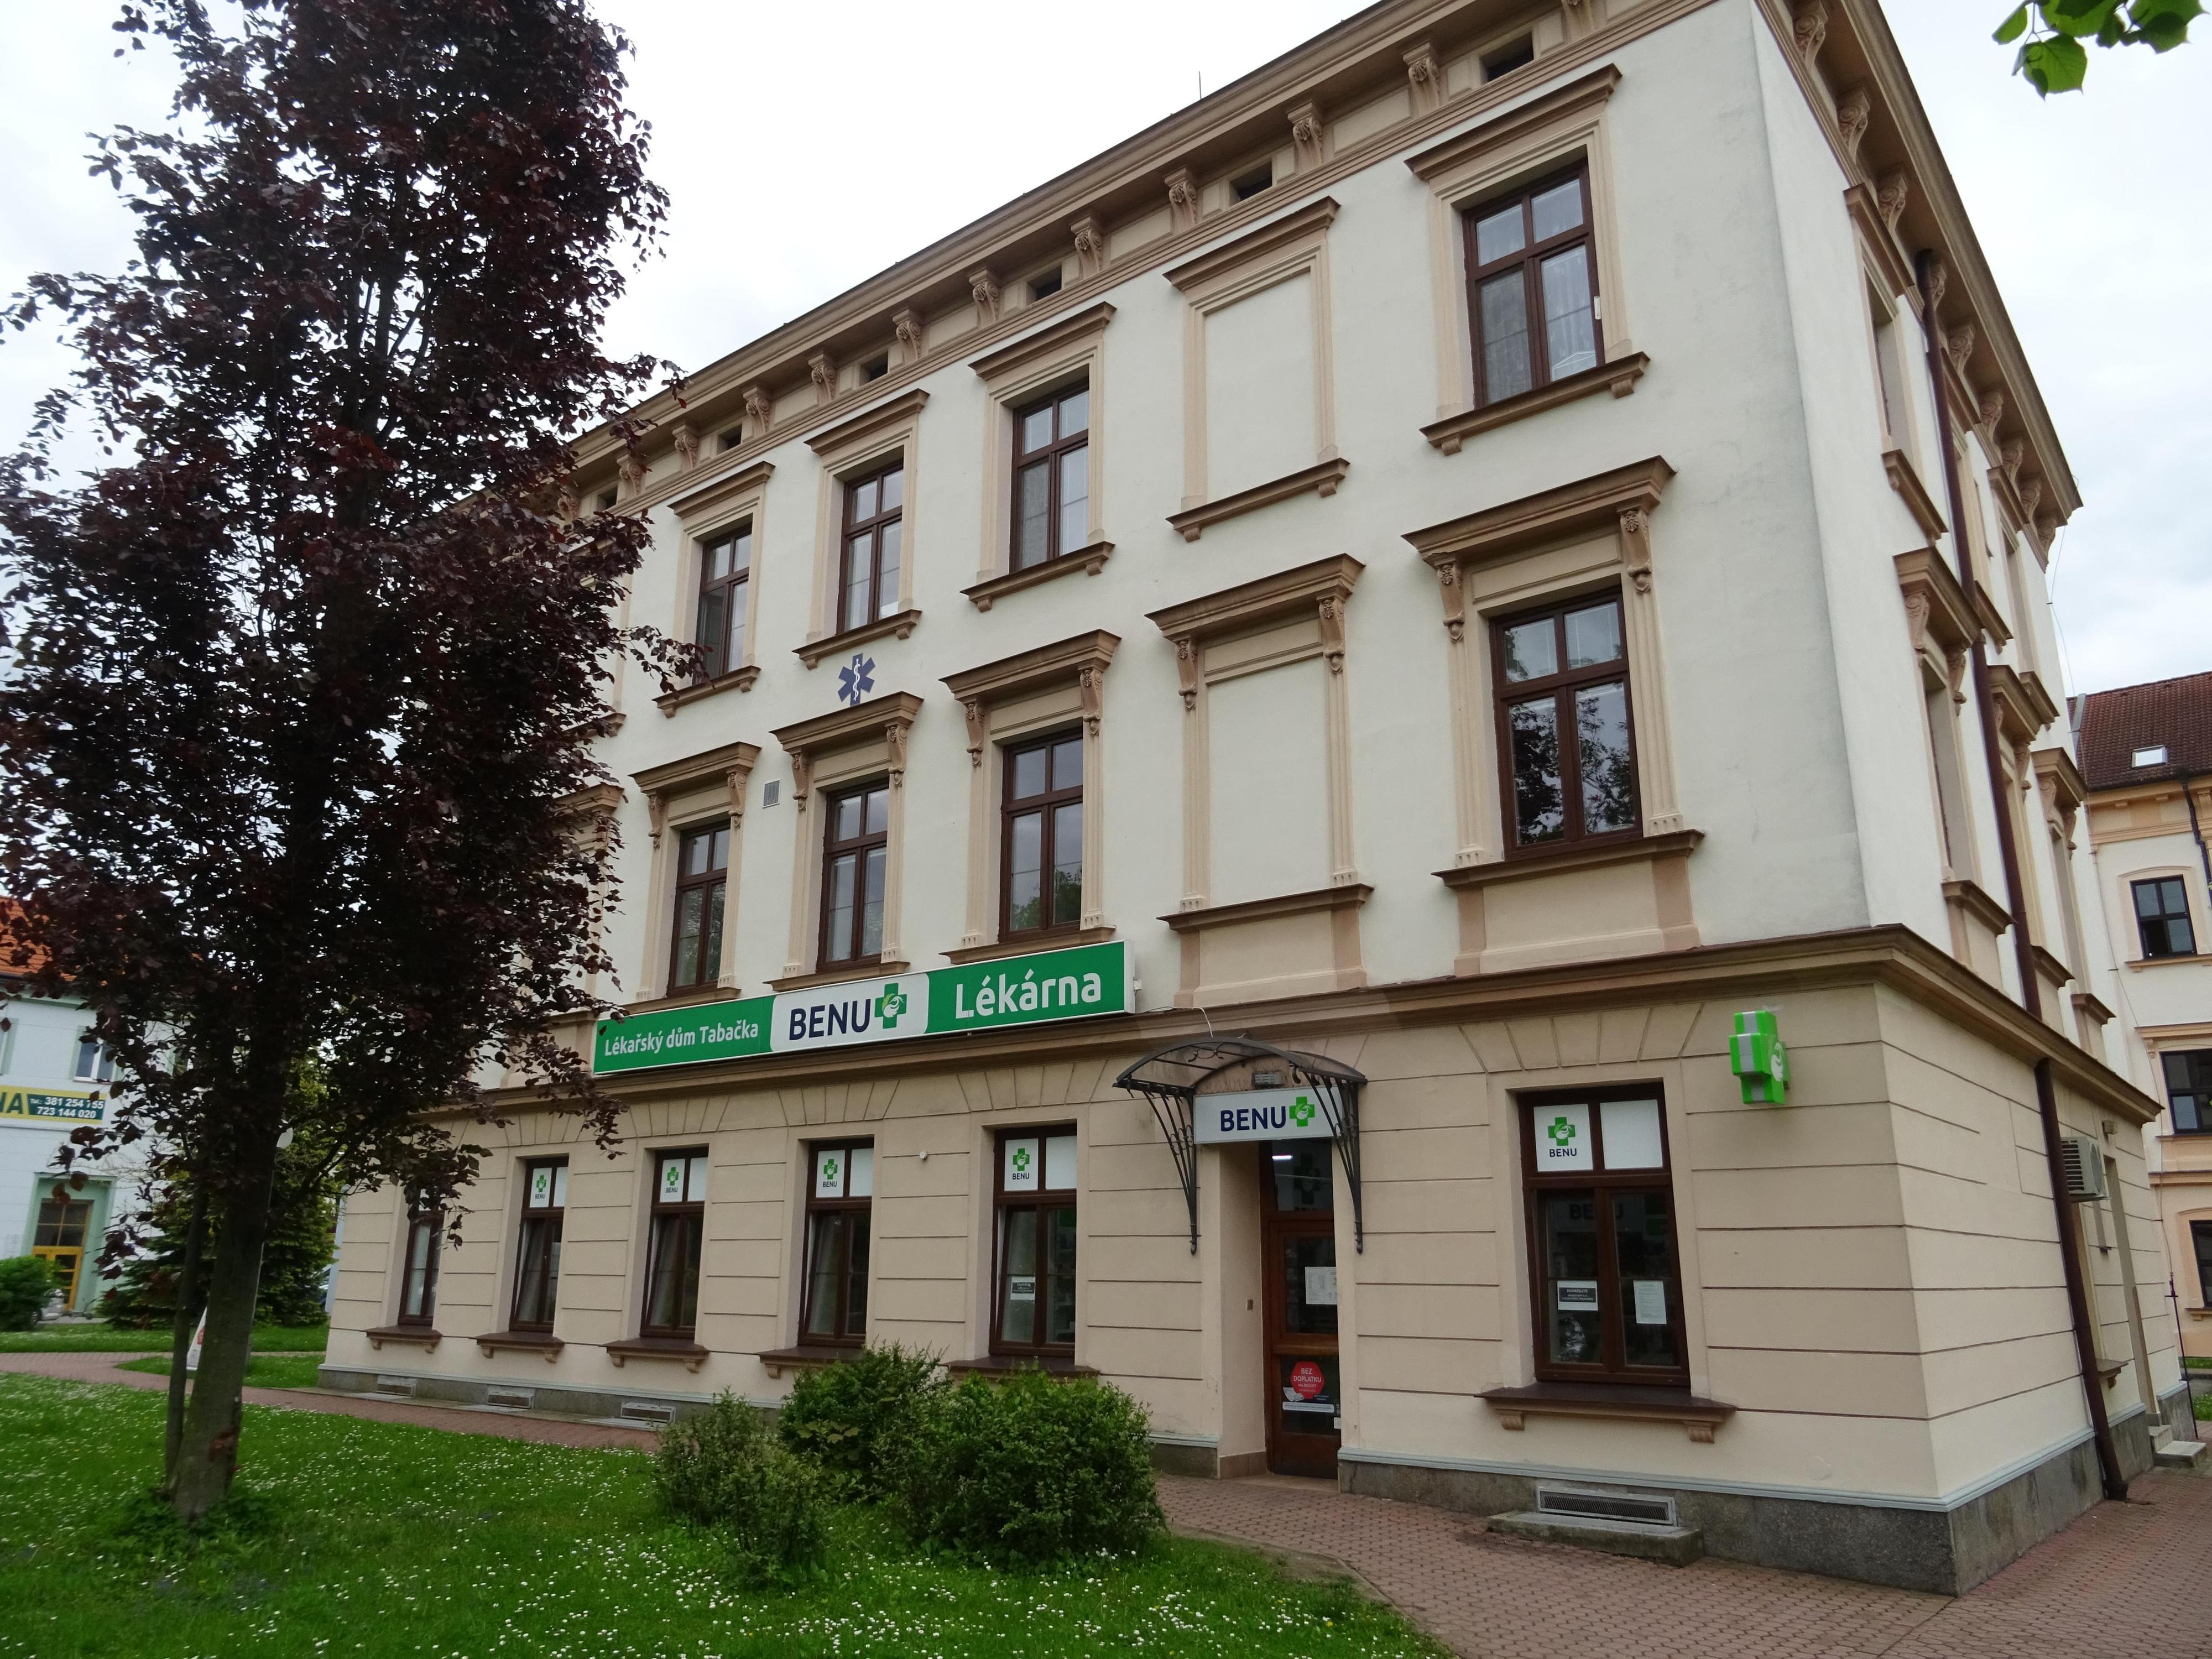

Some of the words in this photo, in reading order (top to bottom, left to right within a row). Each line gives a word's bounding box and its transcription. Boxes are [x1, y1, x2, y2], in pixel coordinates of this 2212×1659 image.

[955, 968, 1102, 1019] Lékárna
[789, 998, 871, 1041] BENU
[604, 1030, 664, 1056] Lékařský
[666, 1026, 696, 1048] dům
[699, 1019, 759, 1044] Tabačka
[37, 1107, 55, 1116] 723
[58, 1108, 76, 1117] 144
[78, 1110, 97, 1119] 020
[44, 1097, 63, 1106] 381
[65, 1098, 85, 1108] 254
[1220, 1105, 1286, 1132] BENU
[1549, 1147, 1577, 1157] BENU
